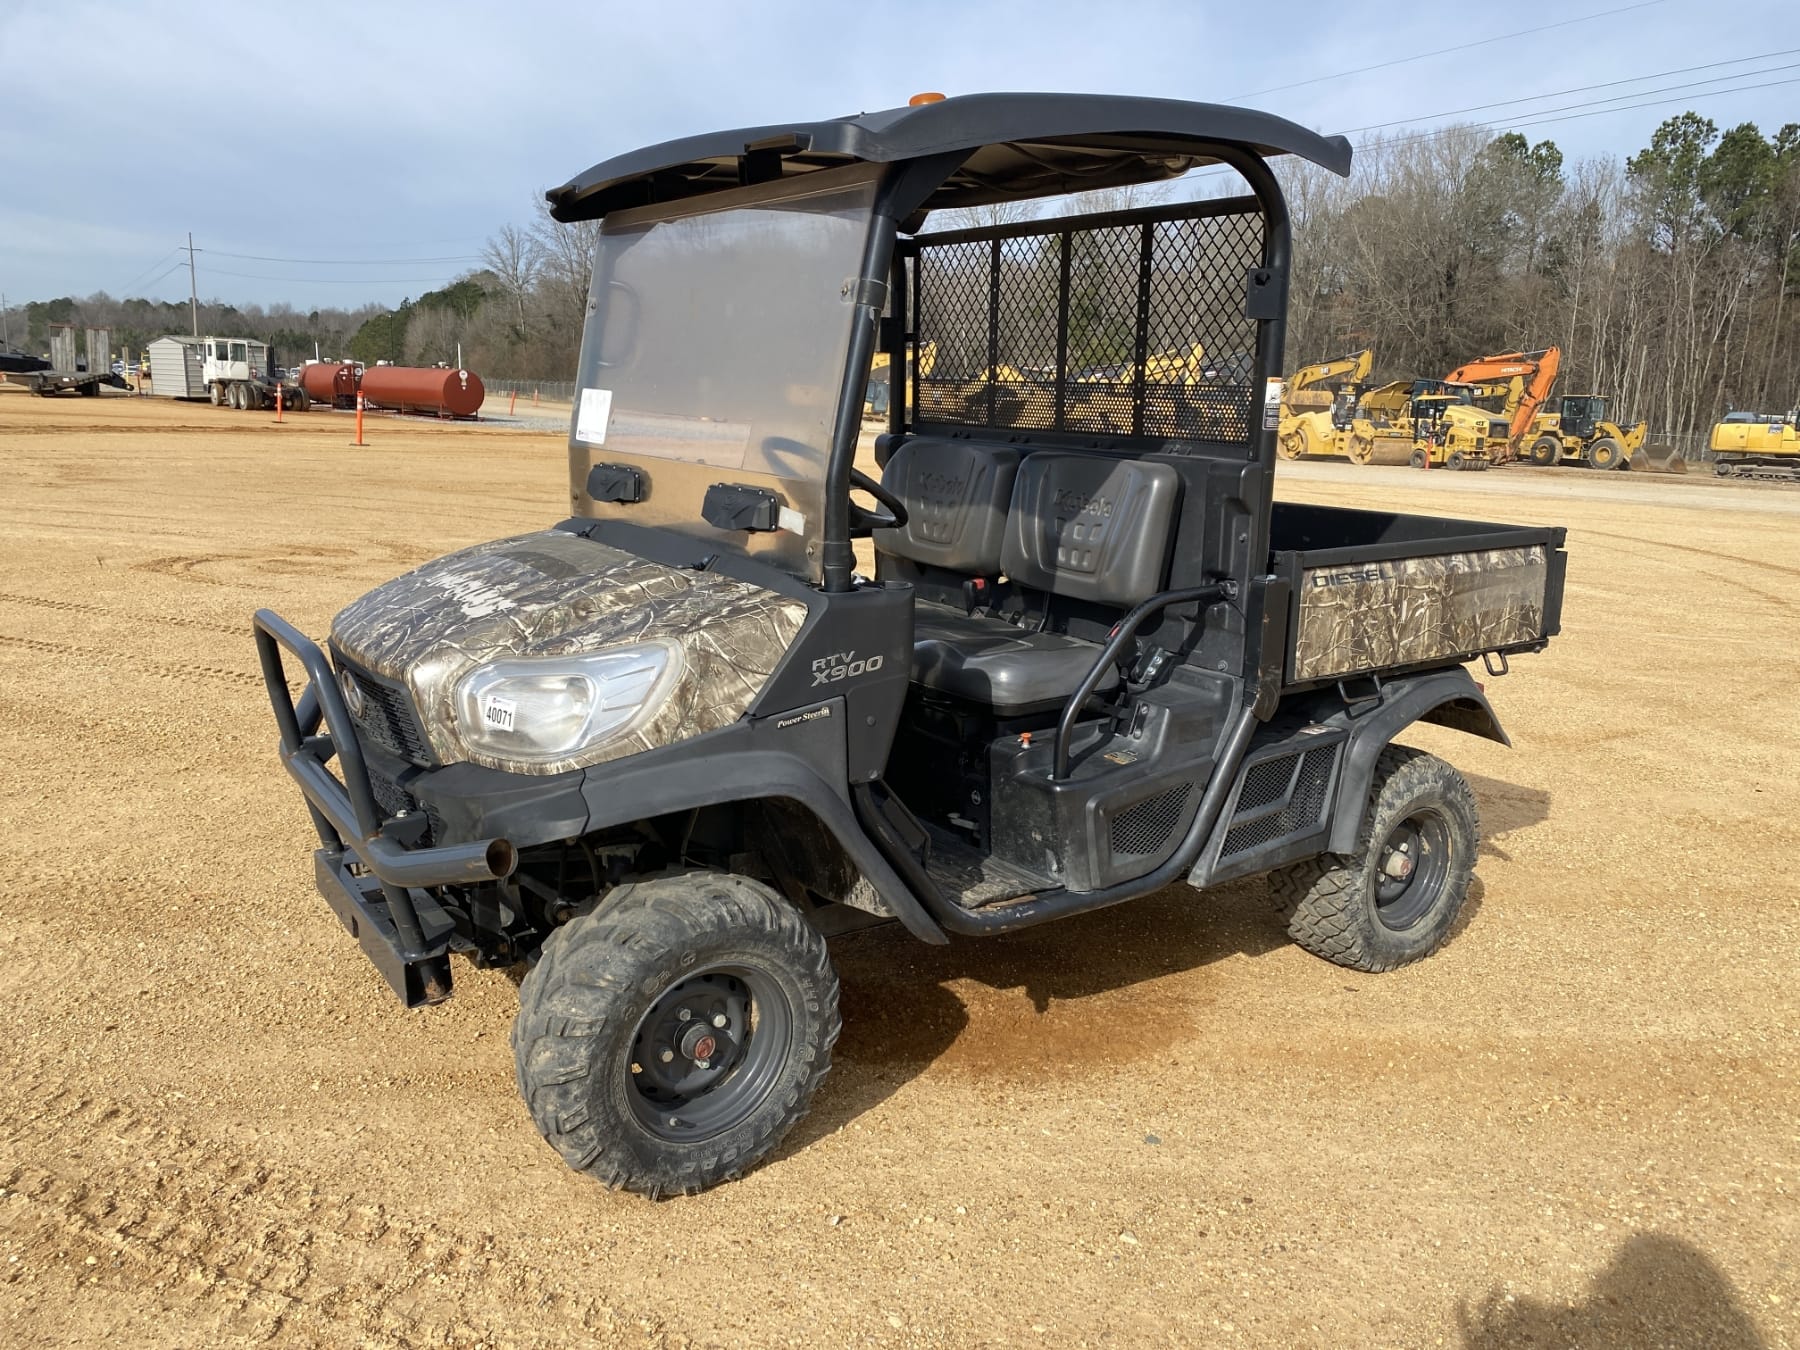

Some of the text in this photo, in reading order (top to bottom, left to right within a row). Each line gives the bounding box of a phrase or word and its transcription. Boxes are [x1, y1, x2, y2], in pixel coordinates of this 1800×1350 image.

[1312, 568, 1393, 587] DIESEL
[810, 655, 884, 688] X900
[811, 650, 856, 672] RTV
[486, 706, 512, 727] 40071
[777, 716, 802, 729] Power
